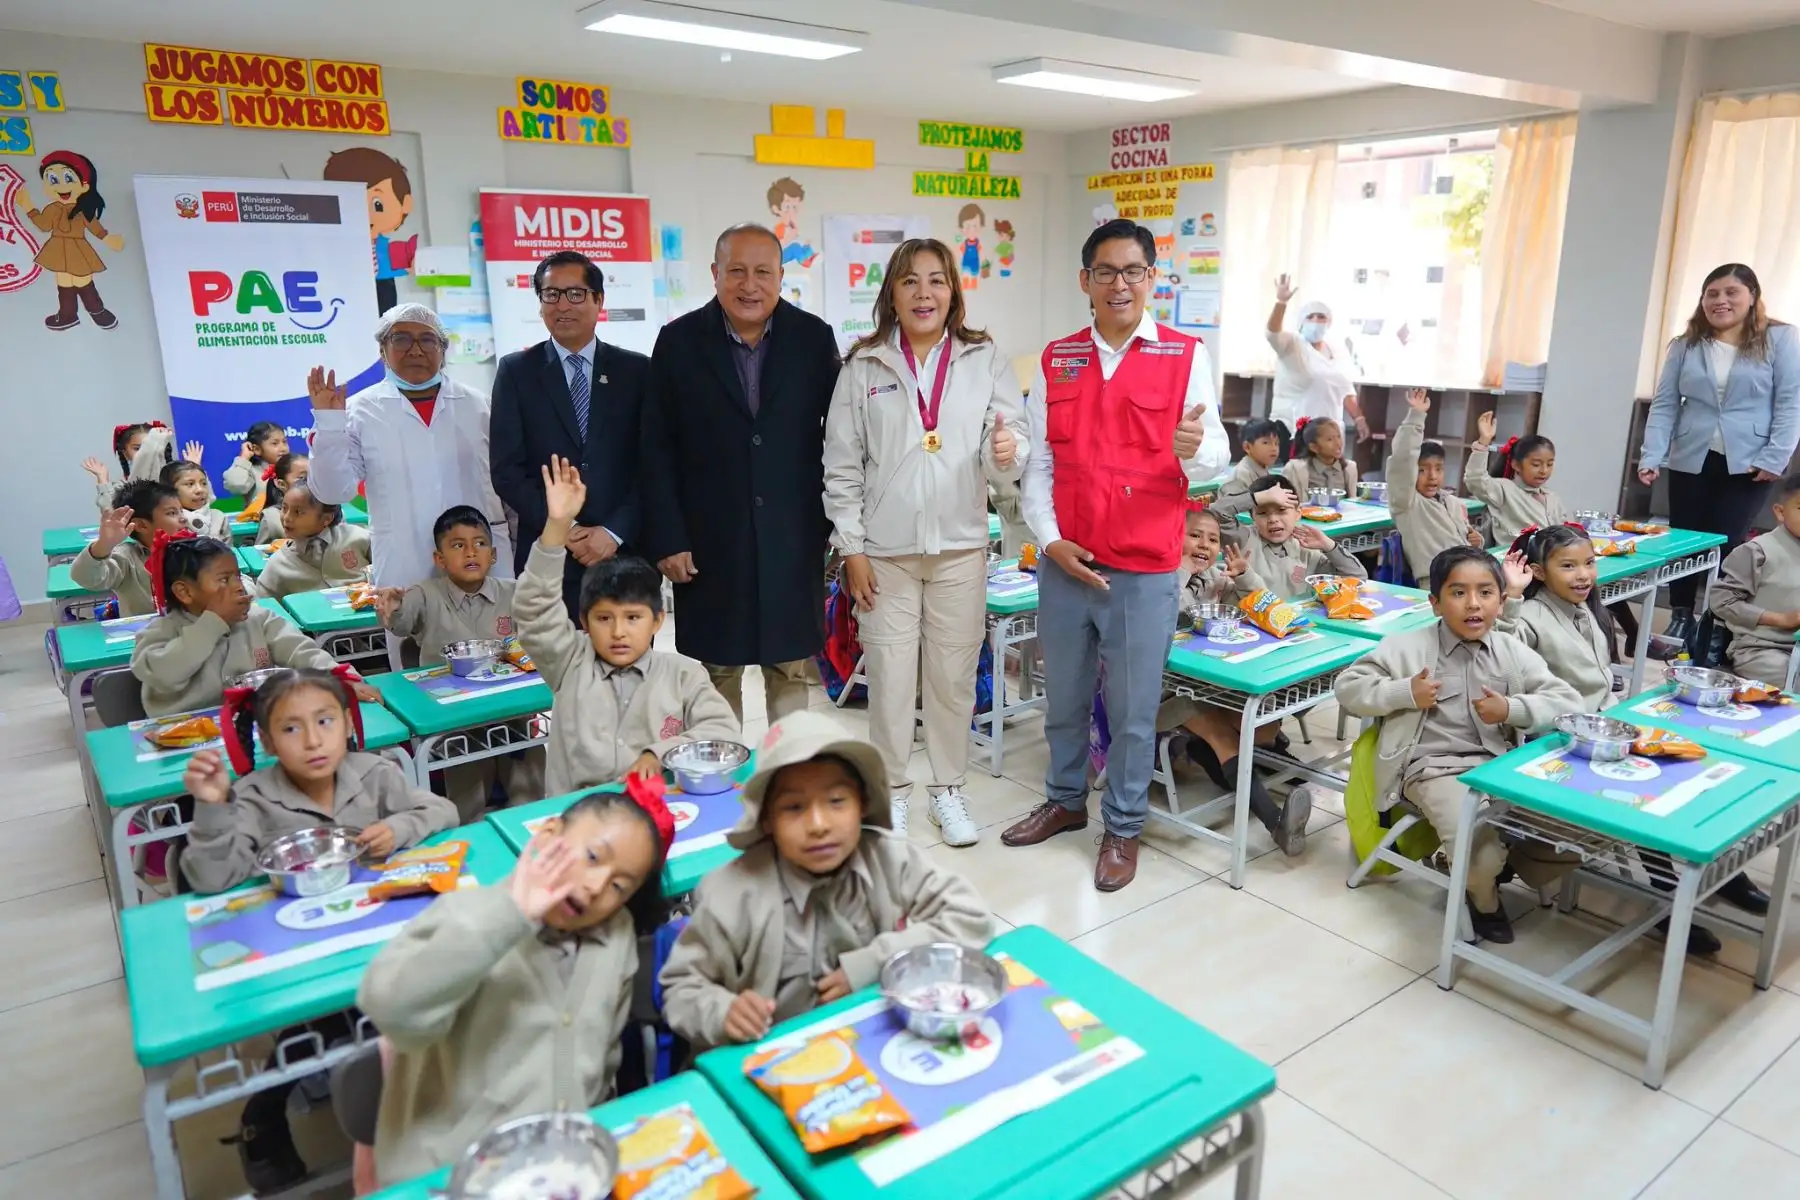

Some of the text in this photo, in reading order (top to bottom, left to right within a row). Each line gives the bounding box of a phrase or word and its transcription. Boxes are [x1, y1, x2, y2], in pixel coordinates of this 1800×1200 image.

[150, 48, 379, 96] JUGAMOS CON
[31, 75, 61, 108] Y
[522, 79, 607, 114] SOMOS
[149, 86, 385, 132] LOS NÚMEROS
[503, 110, 628, 144] ARTISTAS
[919, 123, 1023, 151] PROTEJAMOS
[1112, 123, 1170, 147] SECTOR
[968, 152, 988, 172] LA
[1111, 148, 1169, 170] COCINA
[915, 174, 1020, 198] NATURALEZA
[1145, 171, 1157, 184] ES
[1181, 166, 1213, 180] FORMA
[241, 195, 281, 204] Ministerio
[1165, 187, 1177, 199] DE
[207, 201, 234, 212] PERÚ
[242, 204, 295, 212] de Desarrollo
[286, 213, 309, 221] Social
[1143, 204, 1174, 217] PROPIO
[514, 205, 625, 239] MIDIS
[514, 240, 628, 249] MINISTERIO DE DESARROLLO
[849, 263, 886, 287] PA
[188, 270, 323, 316] PAE
[195, 321, 276, 334] PROGRAMA DE
[198, 332, 327, 348] ALIMENTACIÓN ESCOLAR
